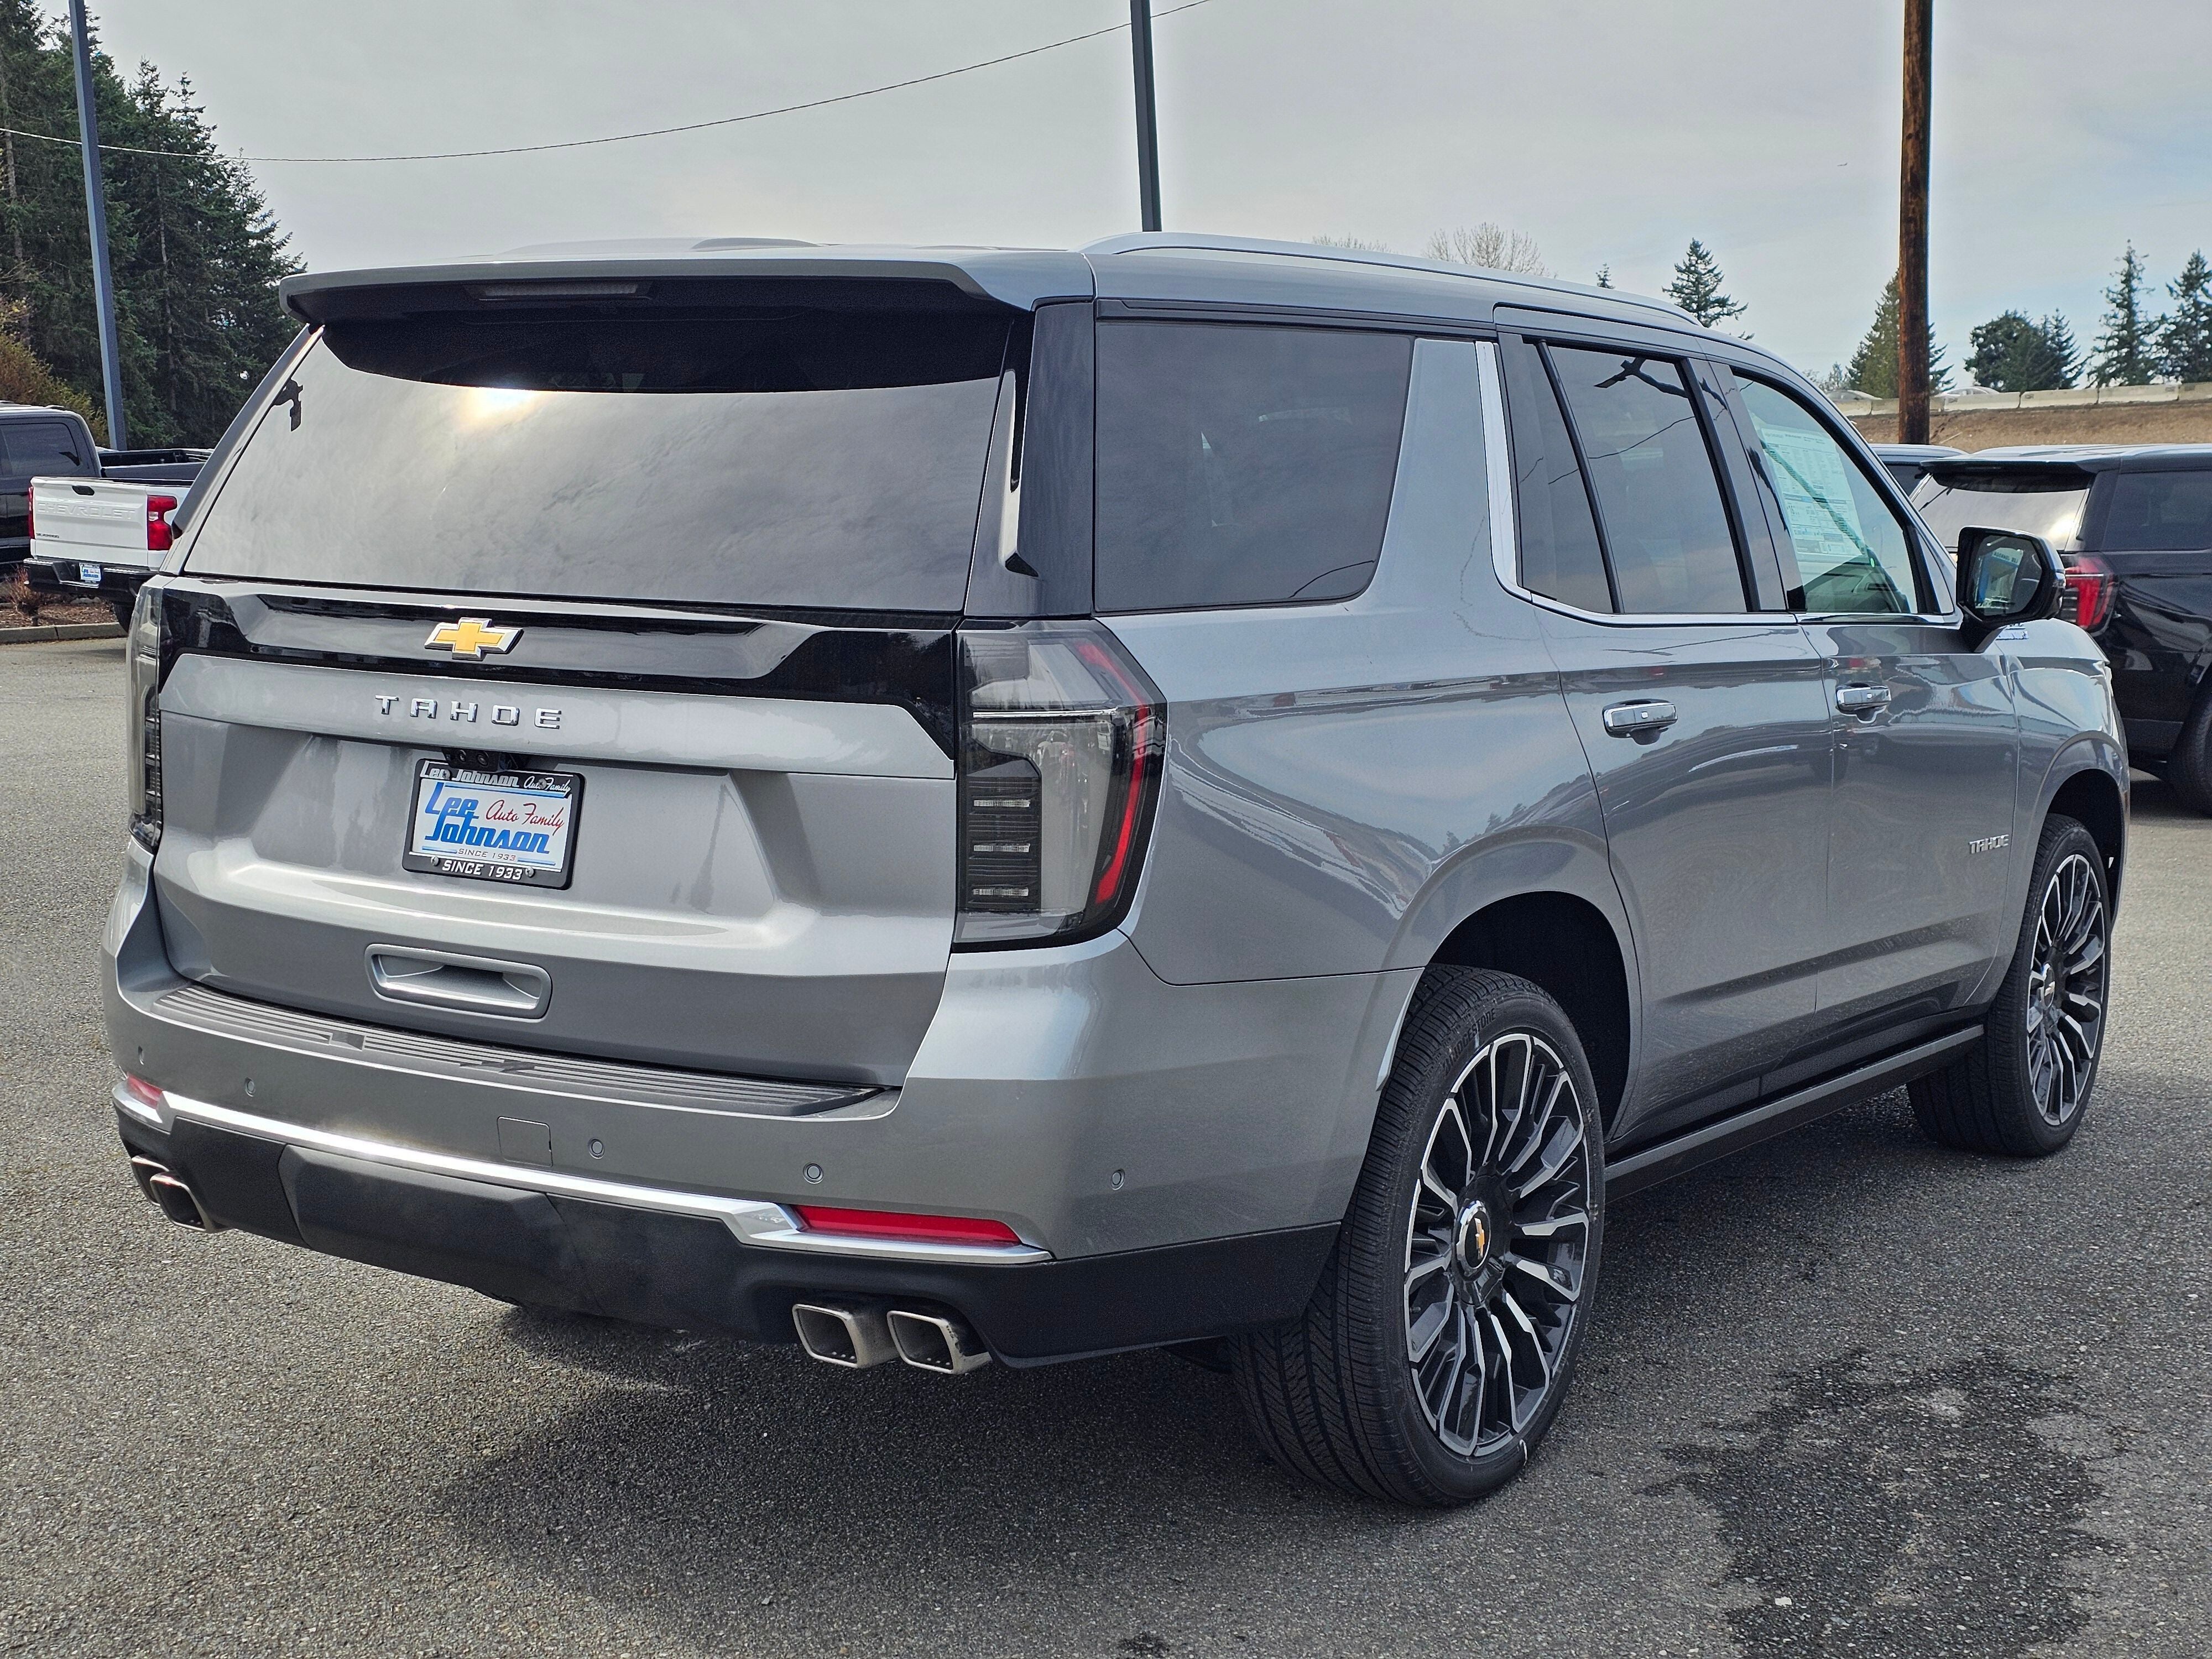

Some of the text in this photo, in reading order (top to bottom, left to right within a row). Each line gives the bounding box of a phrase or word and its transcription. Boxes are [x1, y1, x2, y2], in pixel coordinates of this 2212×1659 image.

[38, 502, 135, 520] CHEVROLET
[375, 695, 562, 729] TAHOE
[452, 769, 520, 787] Johnson
[545, 777, 571, 797] Family
[425, 782, 479, 819] Lee
[486, 800, 565, 836] Auto Family
[425, 815, 550, 854] Johnson
[1969, 834, 2009, 854] TAHOE
[458, 848, 516, 861] SINCE 1933
[442, 860, 523, 880] SINCE 1933
